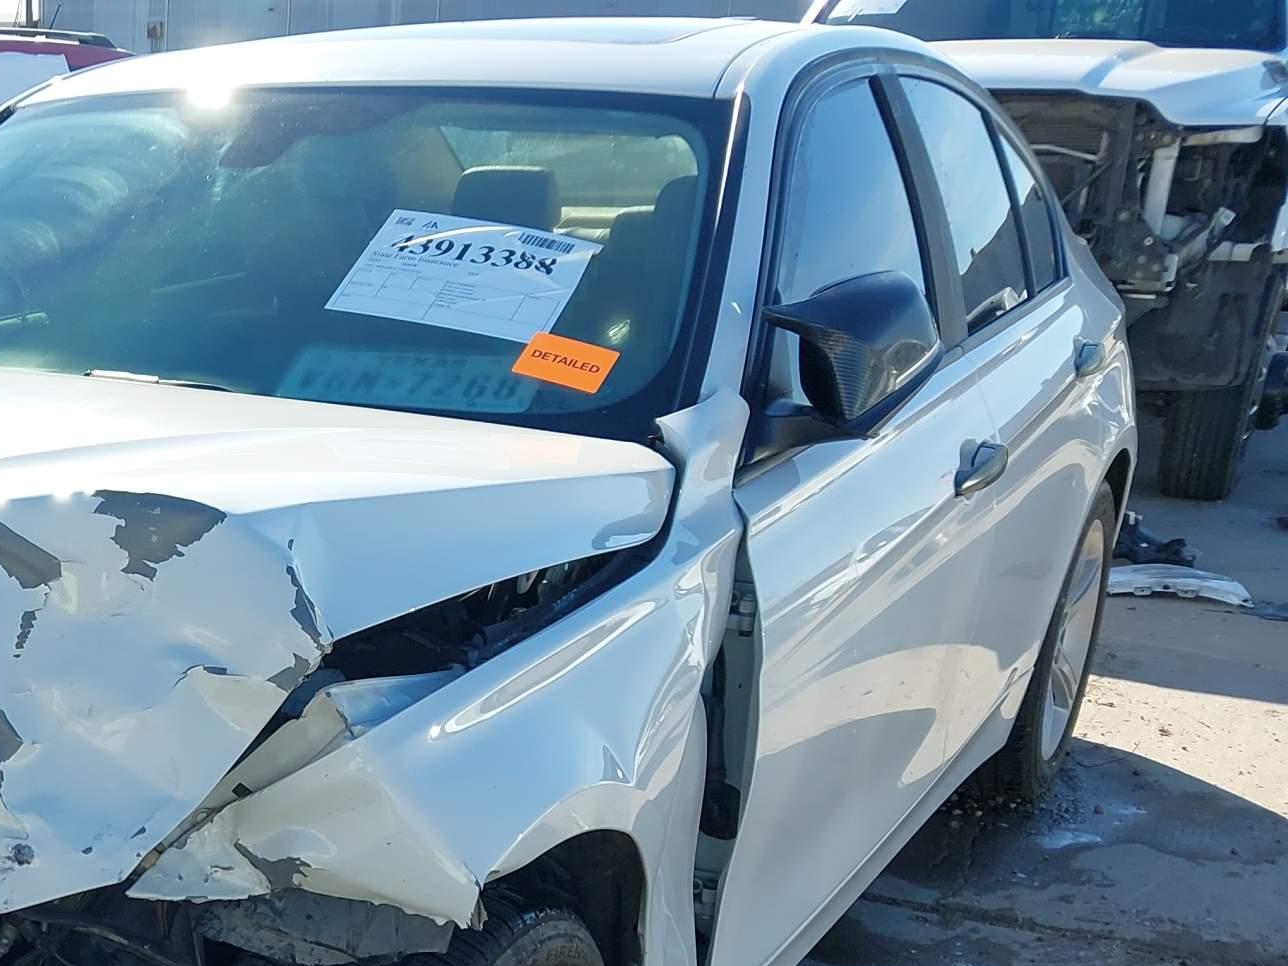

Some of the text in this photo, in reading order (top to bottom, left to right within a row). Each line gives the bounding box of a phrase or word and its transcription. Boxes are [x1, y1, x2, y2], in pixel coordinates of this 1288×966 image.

[391, 234, 557, 276] 43913388
[394, 252, 417, 262] Farm
[418, 256, 460, 268] Insurance
[530, 348, 601, 375] DETAILED
